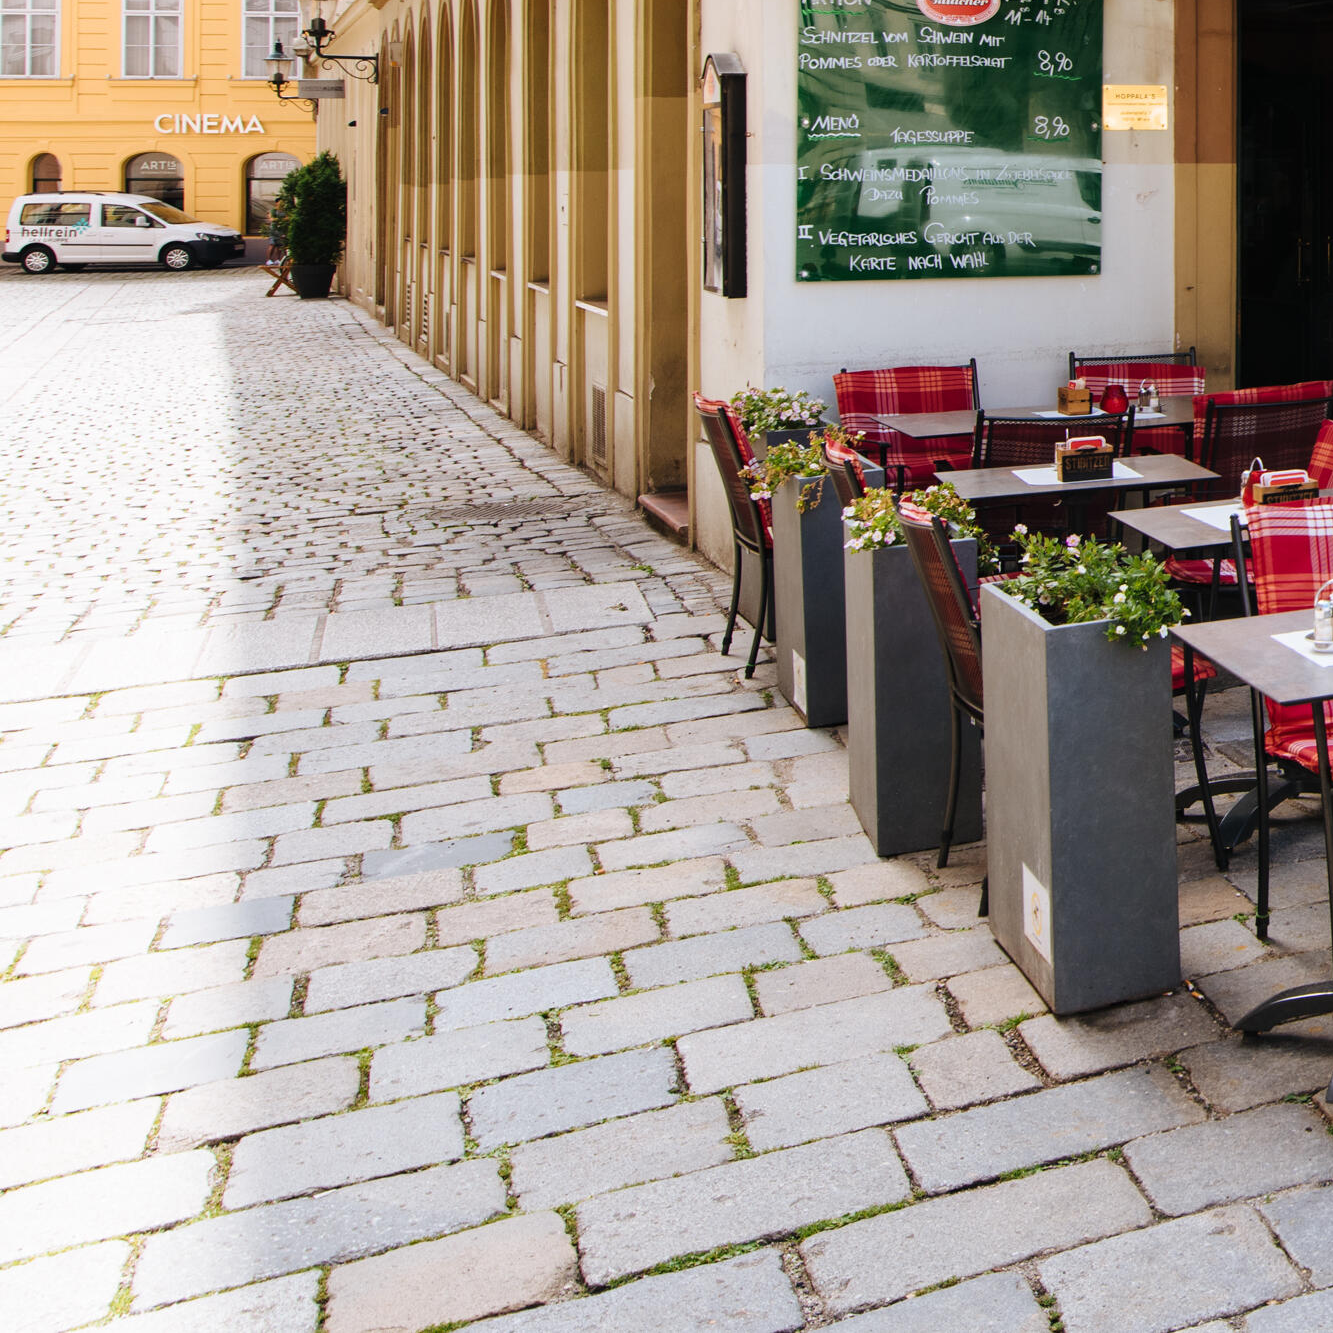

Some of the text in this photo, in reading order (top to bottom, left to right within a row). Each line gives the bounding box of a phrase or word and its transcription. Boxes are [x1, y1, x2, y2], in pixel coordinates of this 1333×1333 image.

[801, 26, 879, 44] SCHNITZEL
[882, 31, 909, 44] VOM
[979, 34, 1006, 47] MIT
[799, 49, 1074, 77] POMMES ODER KARTOFFELSALAT 8,90
[154, 113, 265, 135] CINEMA
[1034, 115, 1070, 140] 8,90
[890, 126, 976, 144] TAGESSUPPE
[976, 169, 991, 181] IN
[863, 185, 980, 206] DAZU POMMES
[21, 226, 78, 238] hellrein
[818, 229, 918, 248] VEGETARISCHES
[923, 222, 981, 246] GERICHT
[982, 230, 1006, 245] AUS
[1007, 230, 1037, 248] DER
[849, 251, 989, 272] KARTE NACH WAHL
